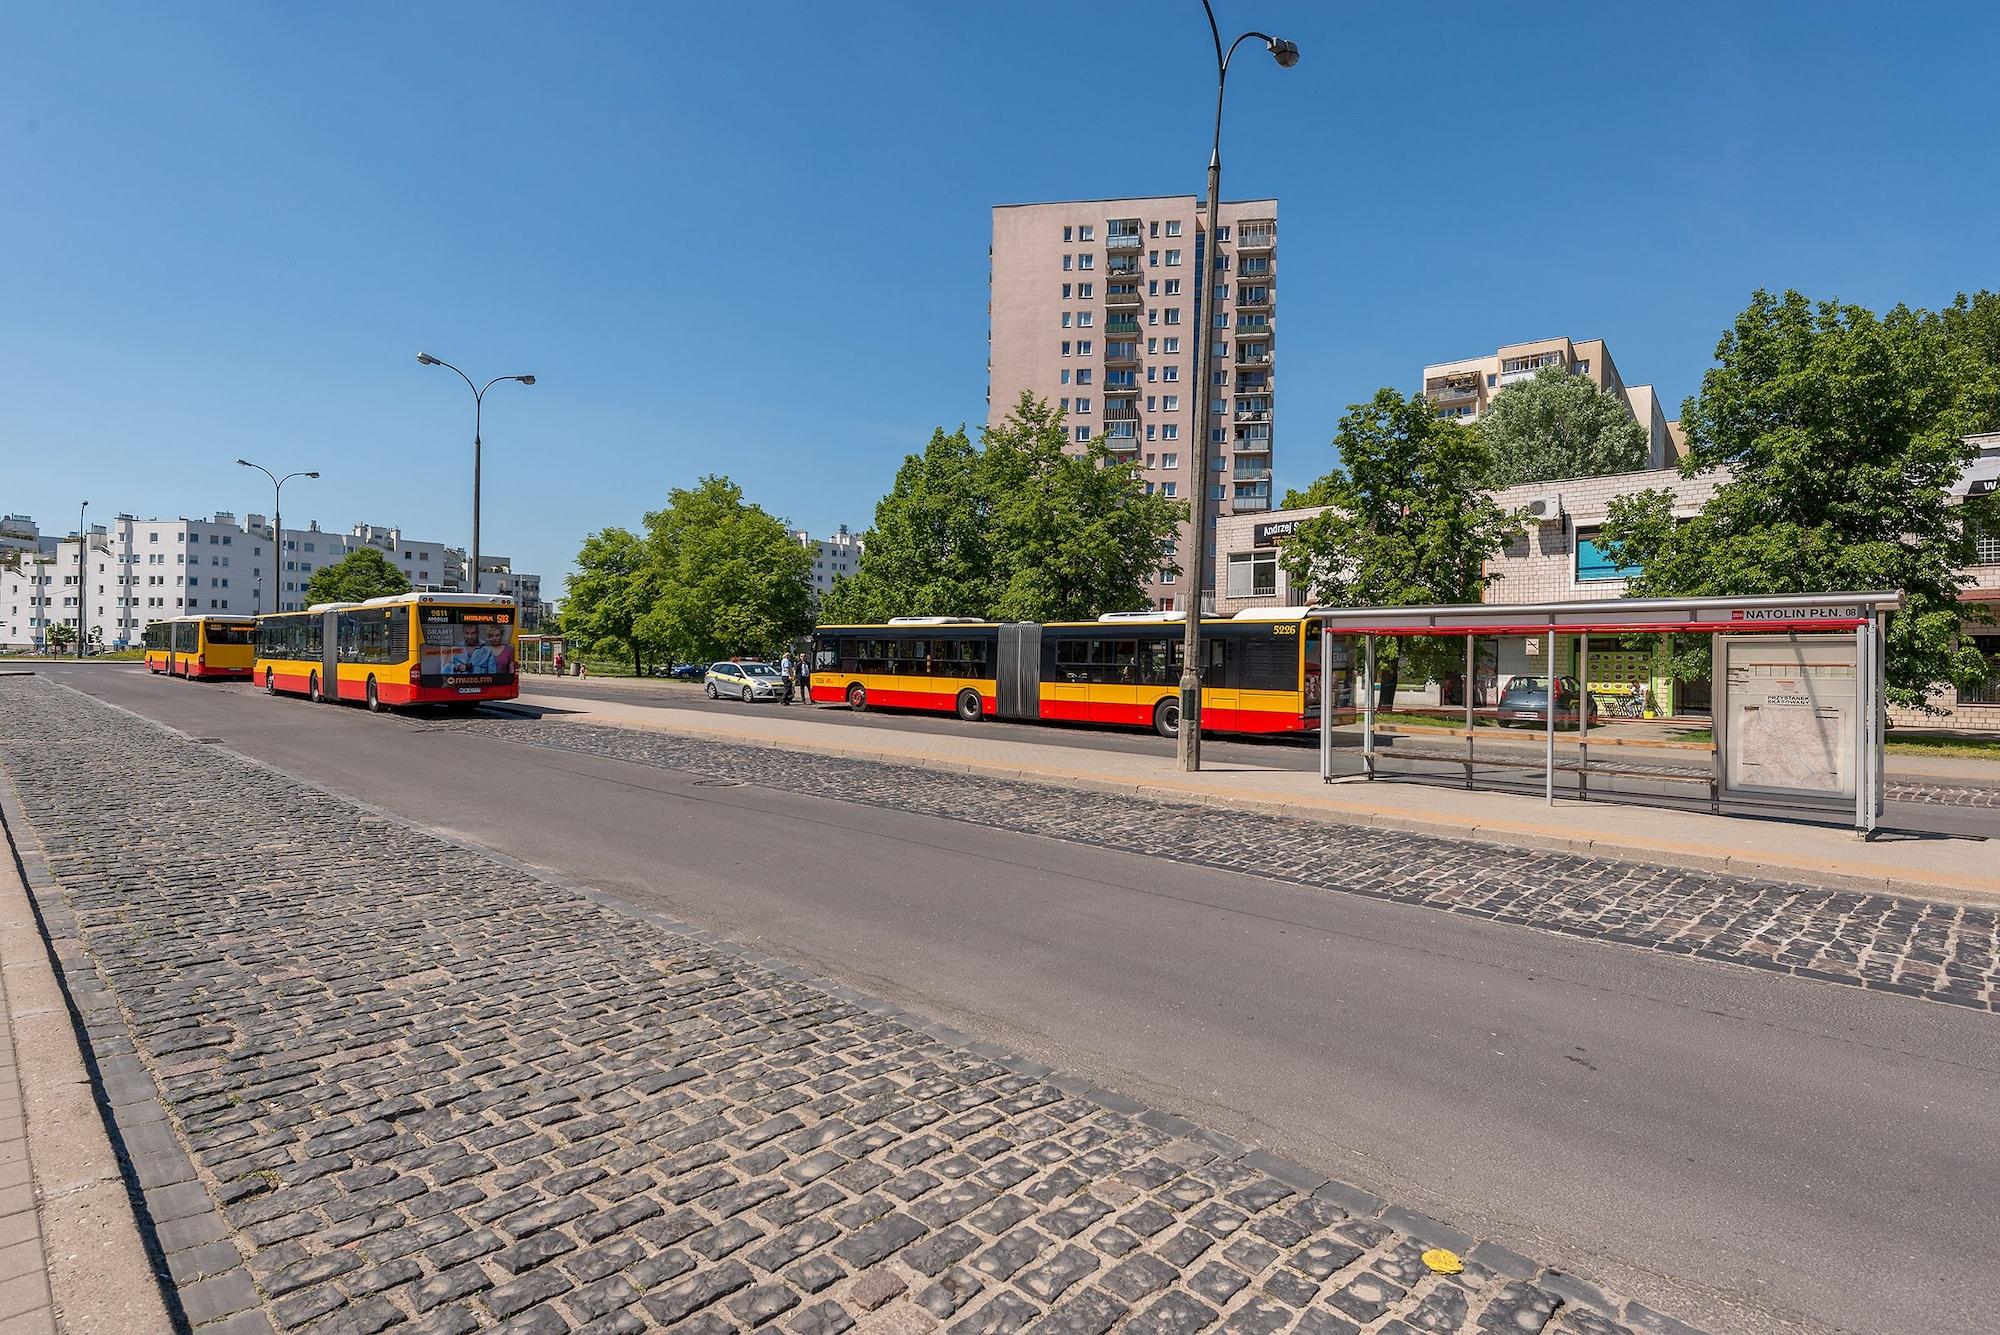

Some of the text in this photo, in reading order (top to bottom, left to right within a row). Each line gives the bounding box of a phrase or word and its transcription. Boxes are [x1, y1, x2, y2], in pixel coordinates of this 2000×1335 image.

[1263, 522, 1293, 537] Andrzej
[431, 609, 448, 617] 9811
[1746, 609, 1808, 619] NATOLIN
[1810, 608, 1841, 618] PŁN.
[1273, 625, 1296, 635] 5226
